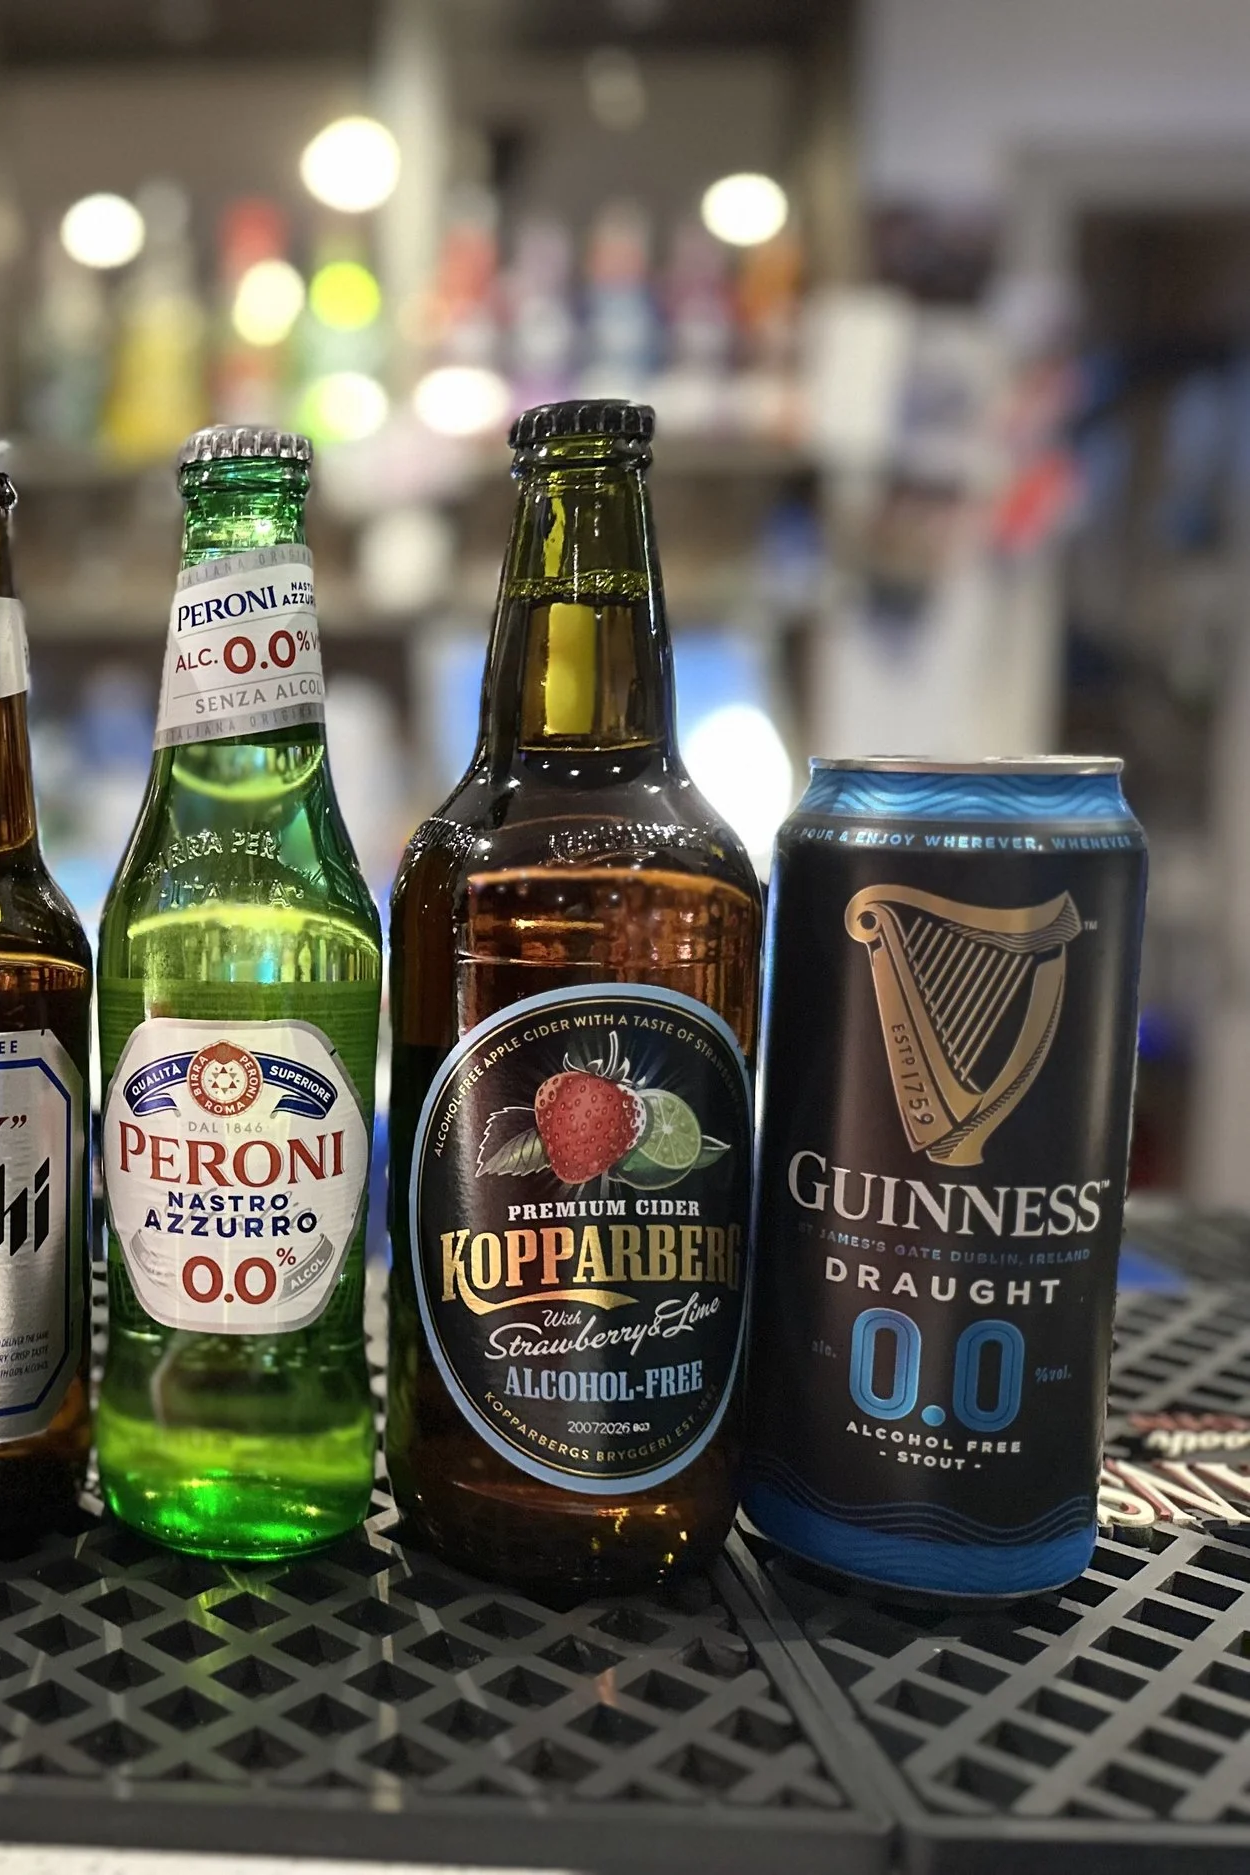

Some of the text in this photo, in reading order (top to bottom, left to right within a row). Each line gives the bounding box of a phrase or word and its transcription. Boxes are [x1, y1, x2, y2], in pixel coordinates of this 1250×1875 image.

[177, 585, 278, 633] PERONI
[175, 647, 219, 674] ALC.
[195, 688, 267, 714] SENZA
[800, 827, 835, 841] POUR
[838, 830, 849, 842] &
[855, 832, 916, 847] ENJOY
[924, 833, 1044, 851] WHEREVER,
[1050, 834, 1132, 850] WHENEVER
[131, 1062, 331, 1103] QUALITÀ SUPERIORE
[190, 1055, 259, 1099] BIRRA PERONI
[433, 1014, 695, 1158] ALCOHOL-FREE APPLE CIDER WITH A TASTE OF
[204, 1100, 246, 1115] ROMA
[900, 1071, 935, 1125] 1759
[188, 1121, 264, 1134] DAL 1846
[118, 1119, 347, 1188] PERONI
[168, 1191, 290, 1213] NASTRO
[507, 1199, 700, 1222] PREMIUM CIDER
[788, 1149, 1102, 1239] GUINNESS
[144, 1208, 318, 1239] AZZURRO
[818, 1228, 887, 1253] JAMES'S
[894, 1244, 941, 1261] GATE
[1029, 1247, 1091, 1265] IRELAND
[290, 1256, 325, 1291] ALCOL
[440, 1222, 741, 1308] KOPPARBERG
[825, 1255, 1061, 1306] DRAUGHT
[484, 1315, 648, 1360] Strawberry
[655, 1291, 720, 1338] Lime
[542, 1309, 583, 1328] With
[10, 1350, 30, 1362] CRISP
[849, 1306, 1026, 1433] 0.0
[503, 1359, 703, 1403] ALCOHOL-FREE
[484, 1391, 590, 1461] KOPPARBERGS
[596, 1434, 672, 1463] BRYGGERI
[566, 1420, 631, 1435] 20072026
[846, 1420, 1022, 1454] ALCOHOL FREE
[897, 1450, 966, 1472] STOUT
